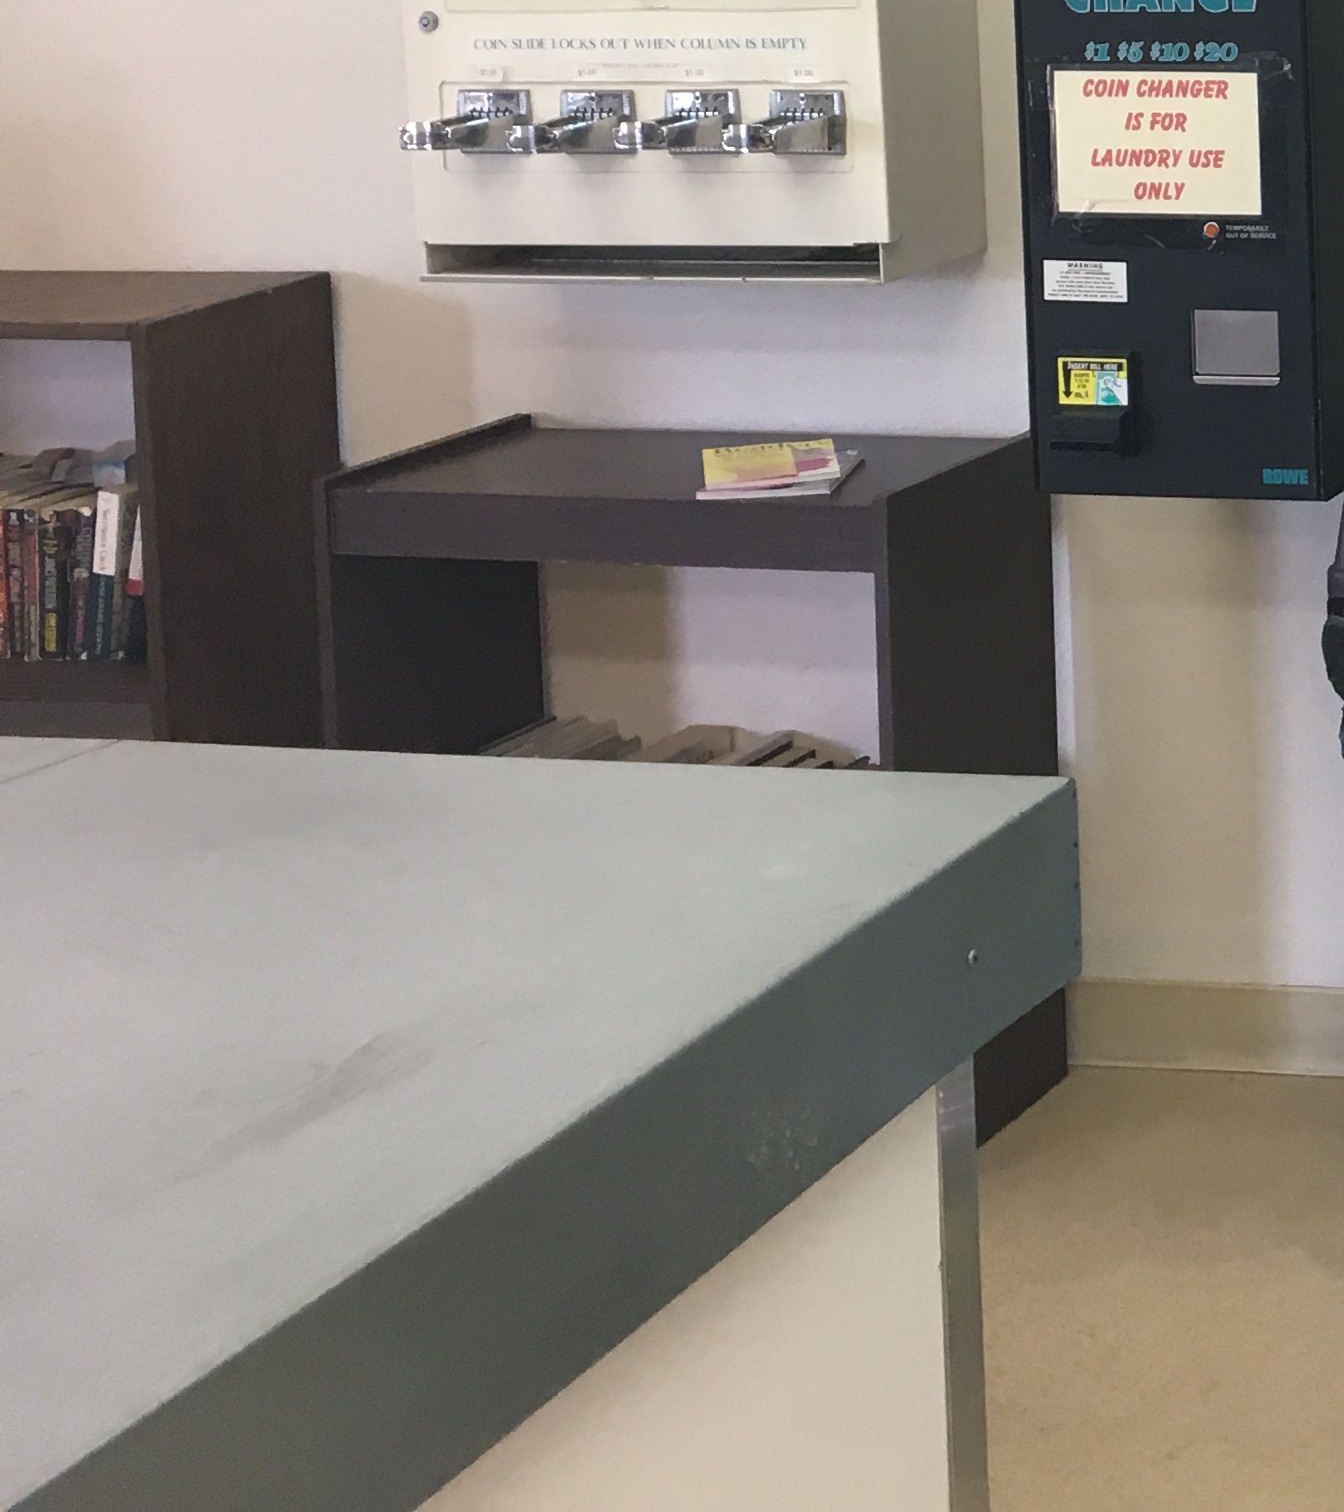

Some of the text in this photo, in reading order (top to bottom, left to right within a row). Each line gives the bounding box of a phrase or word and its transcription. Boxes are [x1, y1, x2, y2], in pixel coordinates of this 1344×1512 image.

[473, 38, 807, 50] COIN SLIDE LOCKS OUT WHEN COLUMN IS EMPTY
[1084, 41, 1238, 62] $1 $5 $10 $20
[1082, 78, 1229, 100] COIN CHANGER
[1124, 112, 1187, 133] IS FOR
[1091, 148, 1226, 169] LAUNDRY USE
[1134, 182, 1186, 200] ONLY
[1262, 467, 1309, 485] ROWE
